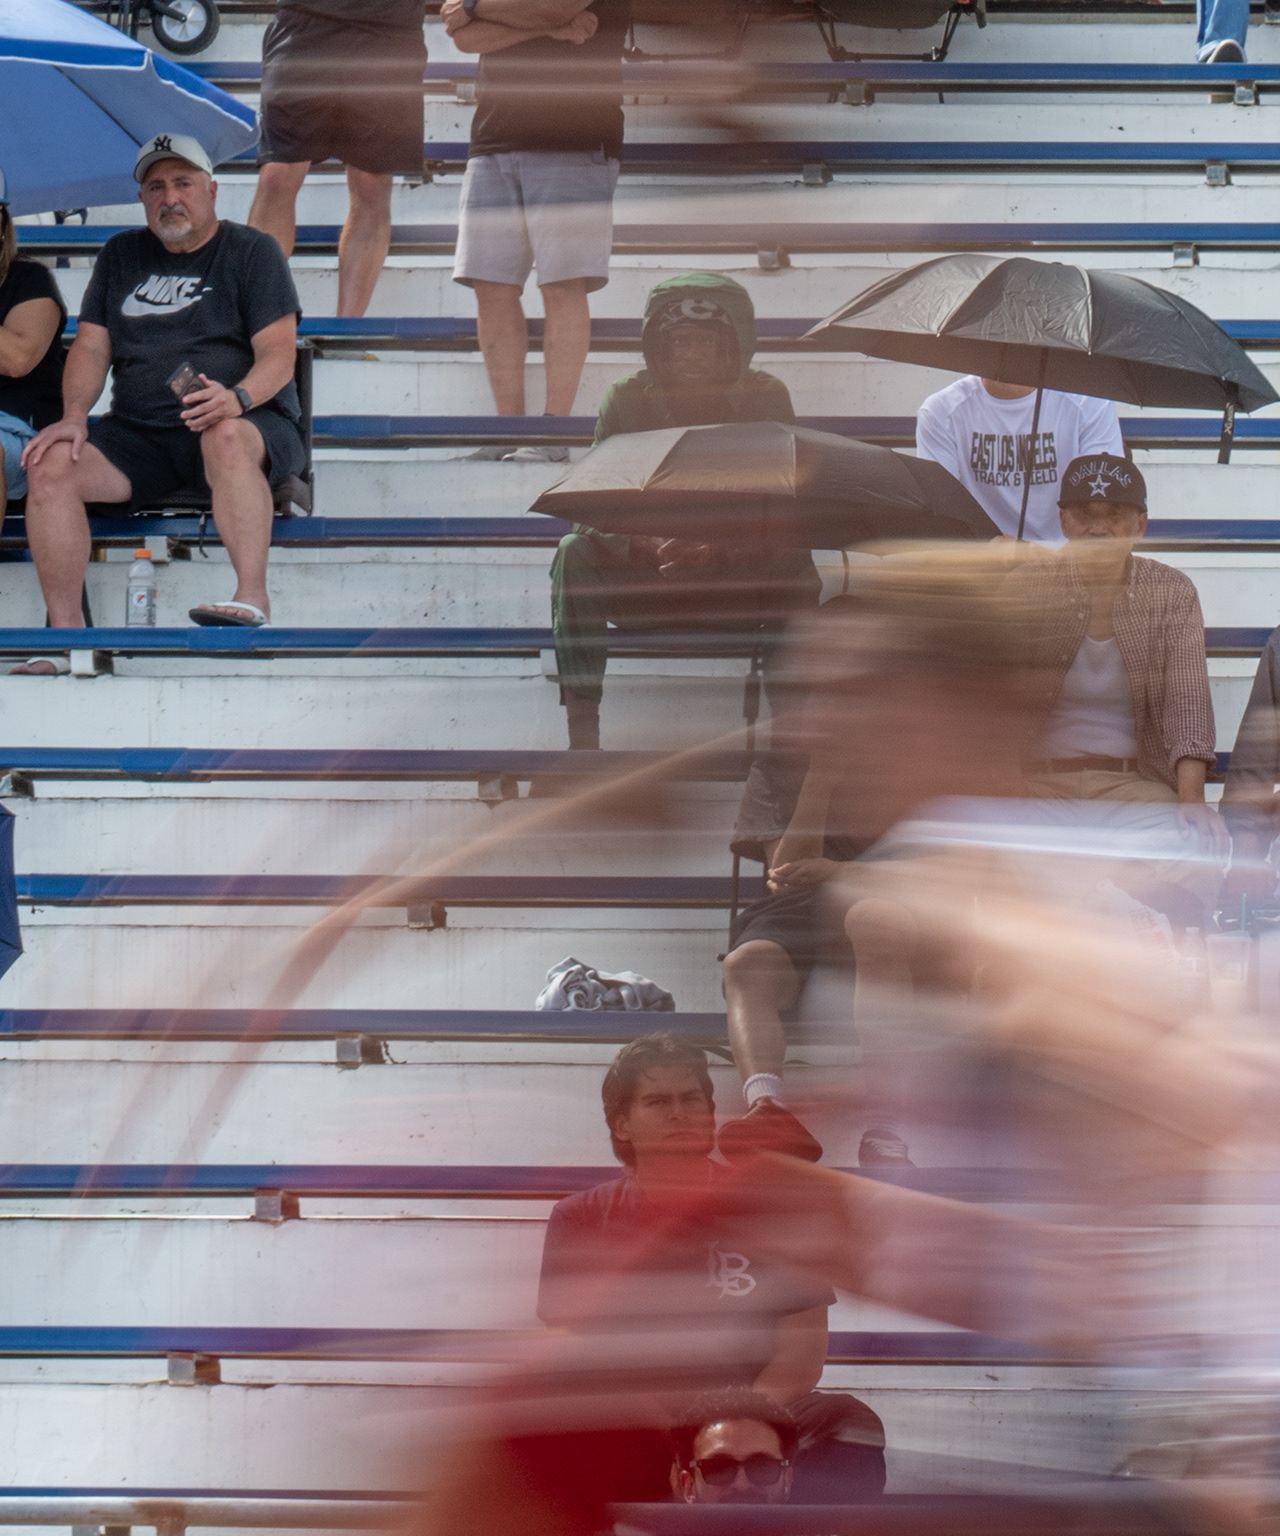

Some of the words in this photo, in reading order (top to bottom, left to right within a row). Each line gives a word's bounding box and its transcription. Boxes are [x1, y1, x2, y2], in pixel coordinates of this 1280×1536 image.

[137, 274, 201, 304] NIKE
[970, 432, 996, 471] EAST
[997, 434, 1015, 473] LOS
[1015, 432, 1058, 473] ANELES
[974, 469, 1011, 487] TRACK
[1013, 472, 1021, 486] &
[1025, 469, 1058, 485] IELD
[1068, 461, 1133, 488] DALLAS
